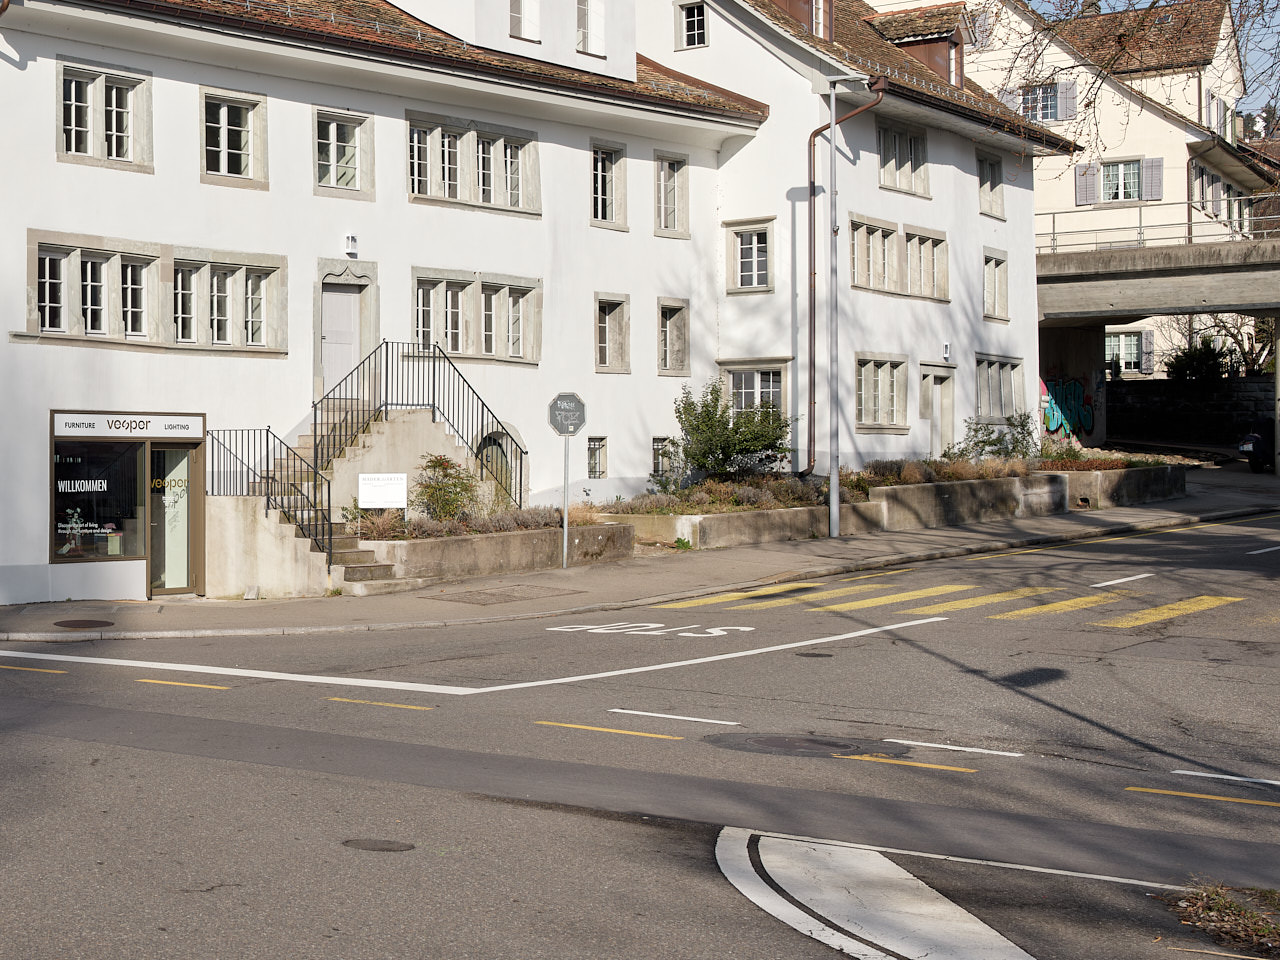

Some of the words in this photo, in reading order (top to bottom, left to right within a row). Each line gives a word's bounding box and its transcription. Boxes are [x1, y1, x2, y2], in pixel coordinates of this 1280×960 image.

[106, 419, 151, 433] vesper
[164, 423, 190, 431] LIGHTING
[57, 479, 108, 493] WILLKOMMEN
[545, 622, 756, 637] STOP
